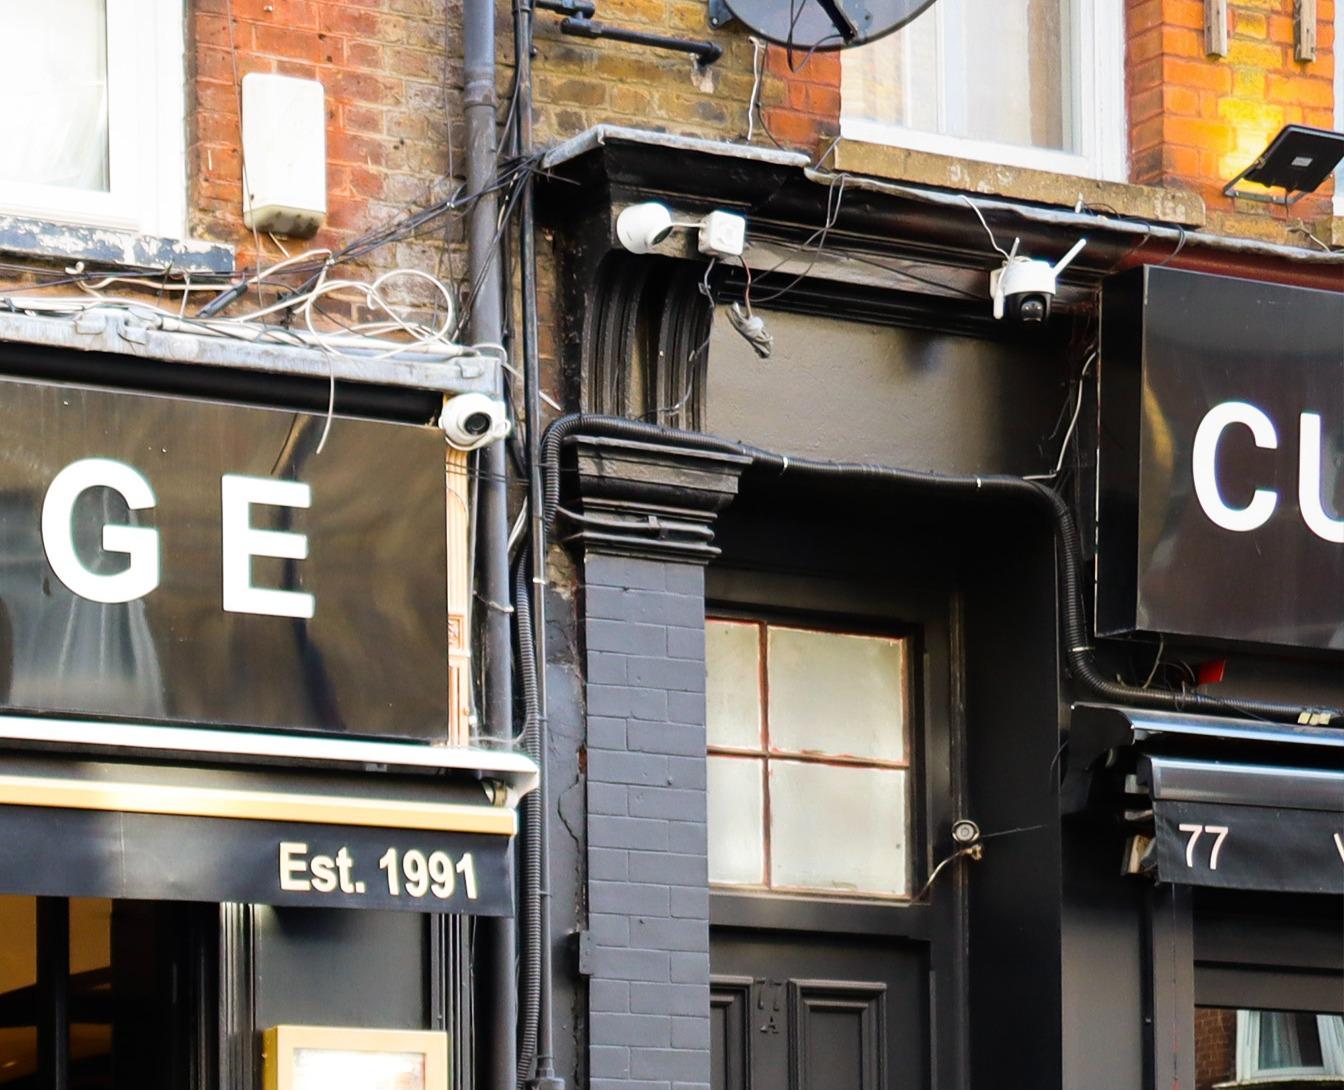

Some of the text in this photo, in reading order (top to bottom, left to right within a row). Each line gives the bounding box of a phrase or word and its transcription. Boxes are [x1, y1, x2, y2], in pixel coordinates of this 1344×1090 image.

[279, 841, 479, 900] Est. 1991
[1178, 823, 1230, 871] 77
